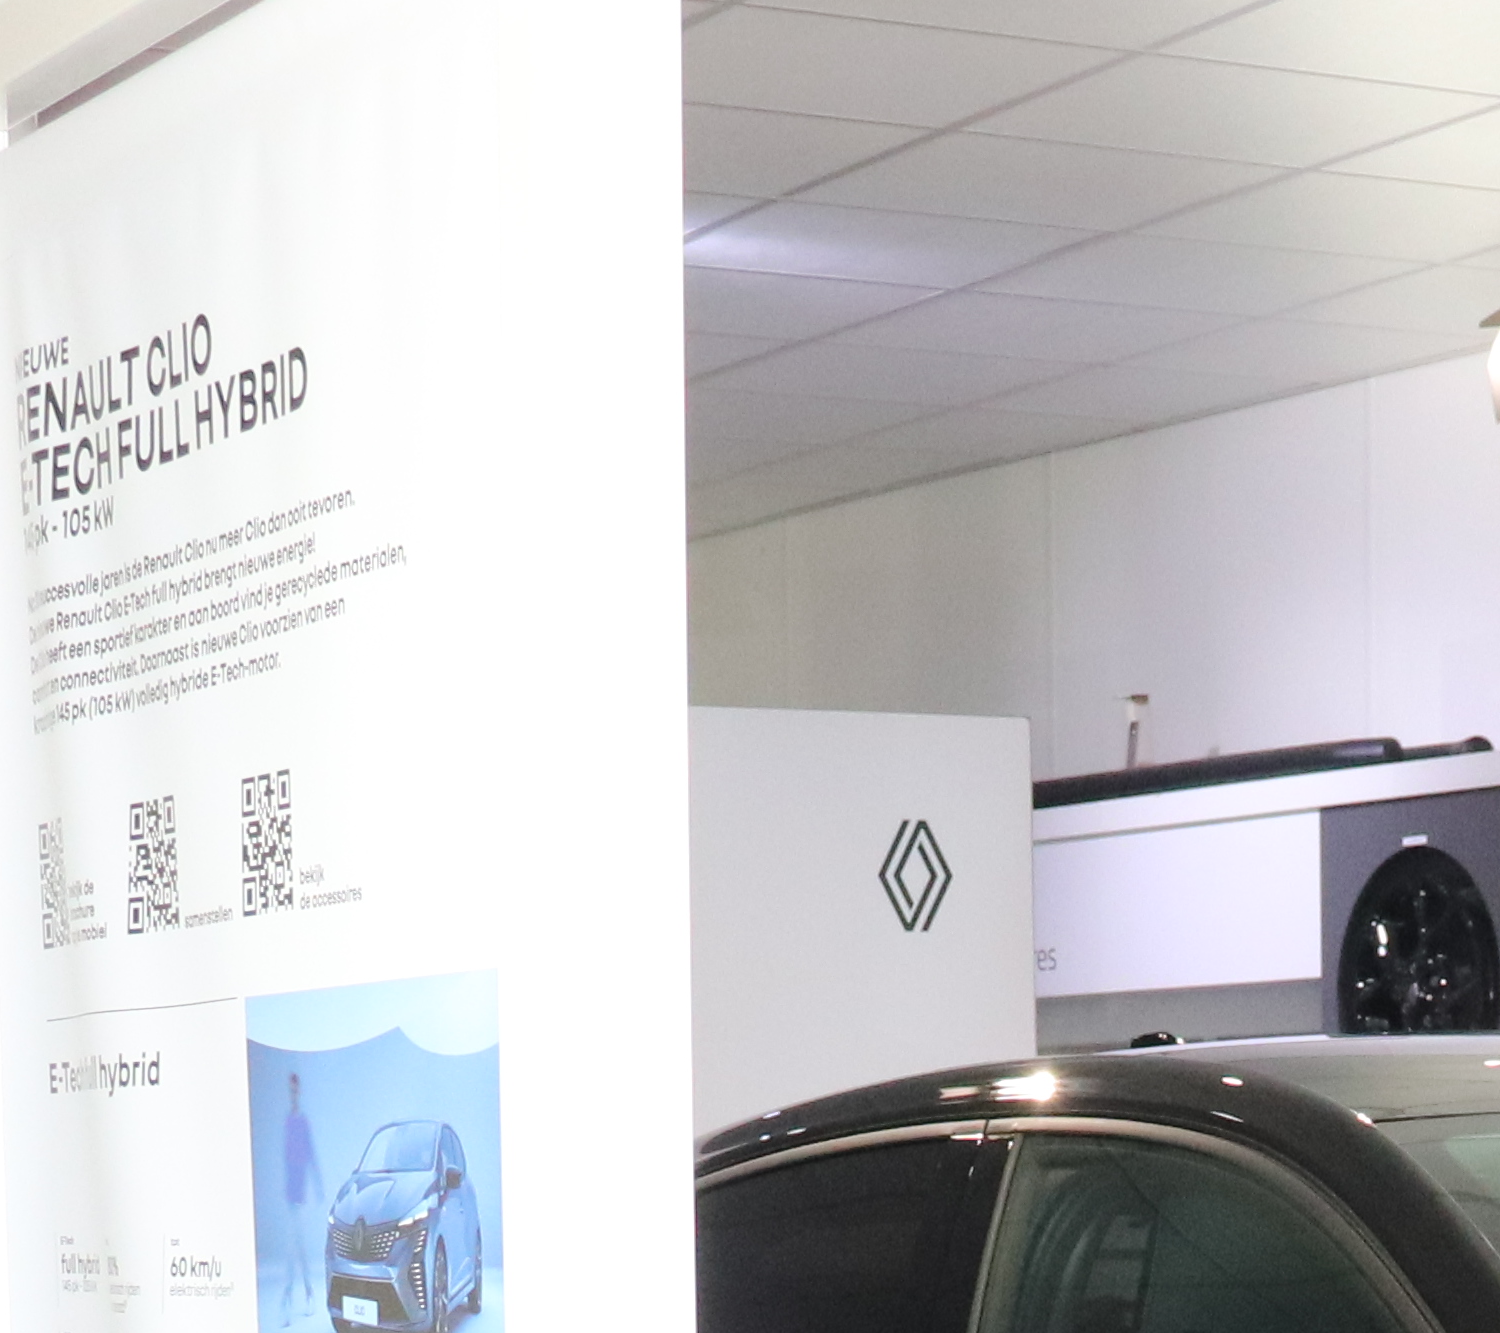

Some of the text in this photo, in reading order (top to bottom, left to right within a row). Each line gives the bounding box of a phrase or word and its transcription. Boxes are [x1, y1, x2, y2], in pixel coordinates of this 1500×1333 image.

[17, 313, 212, 451] RENAULT CLIO
[20, 346, 308, 516] E-TECH FULL HYBRID
[63, 505, 91, 539] 105
[94, 495, 114, 532] kW
[100, 488, 356, 597] jaren de Renault Clio nu meer Clio dan ooit tevoren.
[56, 603, 102, 633] Renault
[103, 598, 123, 624] Clio
[123, 590, 151, 618] E-Tech
[151, 582, 168, 606] full
[169, 570, 203, 605] hybrid
[203, 560, 237, 591] brengt
[238, 549, 275, 578] nieuwe
[276, 530, 317, 568] energie!
[68, 640, 92, 661] een
[93, 624, 135, 660] sportief
[134, 615, 173, 647] karakter
[173, 610, 188, 633] en
[188, 604, 210, 628] aan
[209, 590, 241, 622] boord
[240, 583, 264, 613] vind
[263, 580, 274, 610] je
[274, 560, 339, 607] gerecyclede
[339, 542, 408, 580] materialen,
[60, 656, 140, 694] connectiviteit.
[139, 642, 190, 675] Daarnaast
[190, 636, 200, 660] is
[201, 630, 238, 657] nieuwe
[238, 620, 260, 646] Clio
[259, 606, 303, 638] voorzien
[303, 601, 324, 625] van
[324, 595, 347, 620] een
[71, 696, 88, 727] pk
[88, 693, 114, 723] (105
[114, 686, 136, 715] kW)
[134, 677, 170, 709] volledig
[169, 668, 209, 701] hybride
[209, 650, 282, 687] E-Tech-motor.
[298, 864, 325, 887] bekijk
[299, 883, 364, 911] de accessoires
[184, 904, 234, 930] samenstellen
[99, 1050, 160, 1097] hybrid
[170, 1254, 222, 1282] 60 km/u
